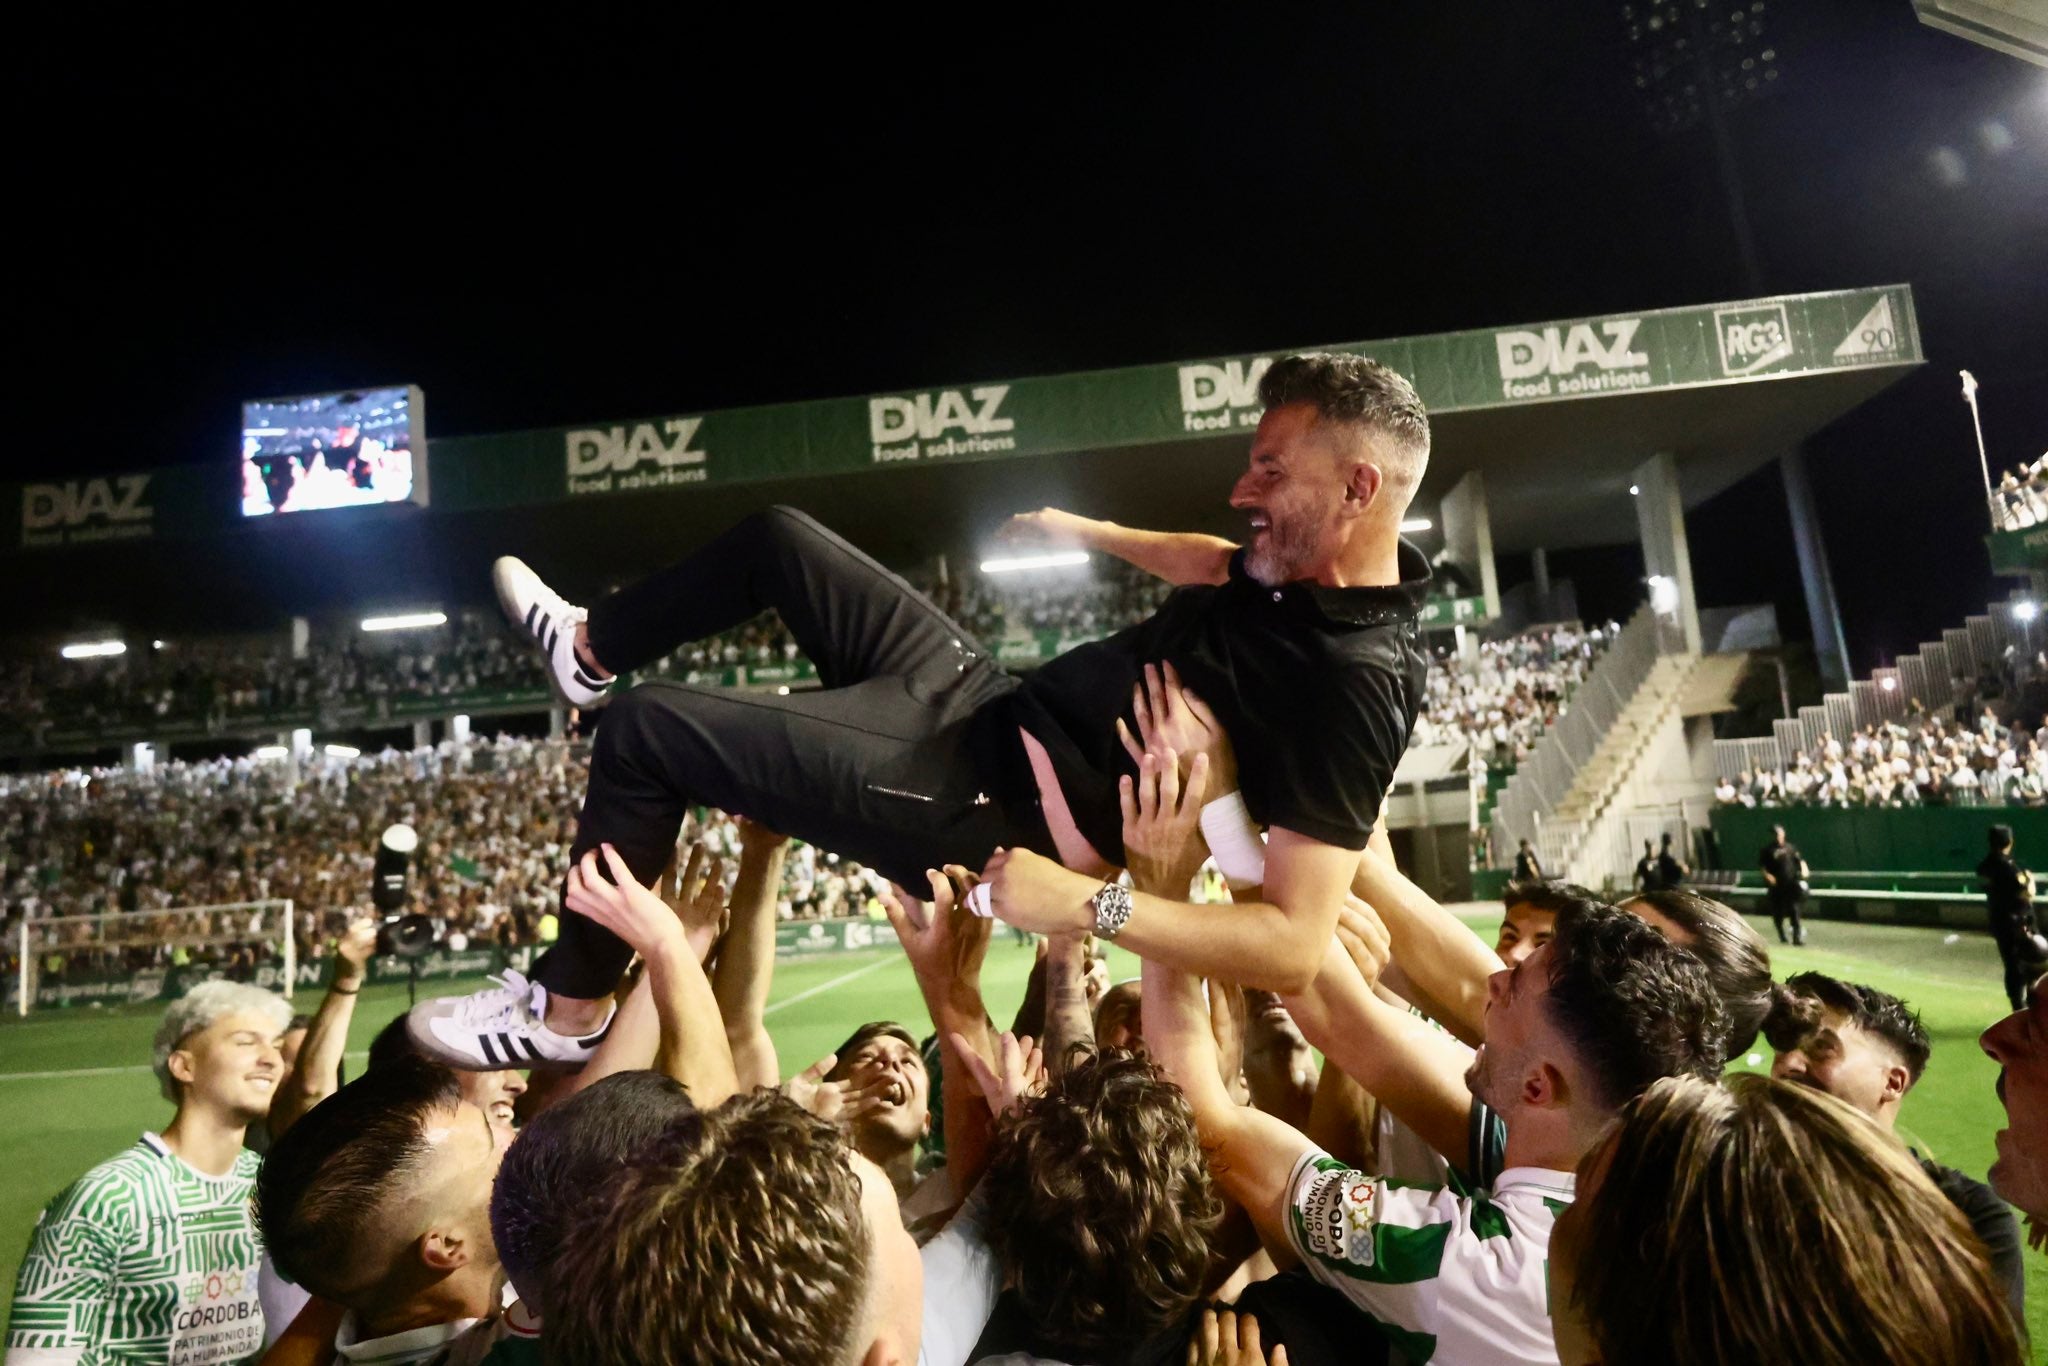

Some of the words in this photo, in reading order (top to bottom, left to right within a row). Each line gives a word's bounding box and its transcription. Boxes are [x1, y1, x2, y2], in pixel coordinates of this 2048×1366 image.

[1495, 319, 1649, 380] DIAZ
[1503, 376, 1552, 399] food
[1558, 370, 1650, 393] solutions
[869, 384, 1015, 444] DIAZ
[1184, 408, 1230, 431] food
[566, 417, 706, 475] DIAZ
[22, 474, 154, 528] DIAZ
